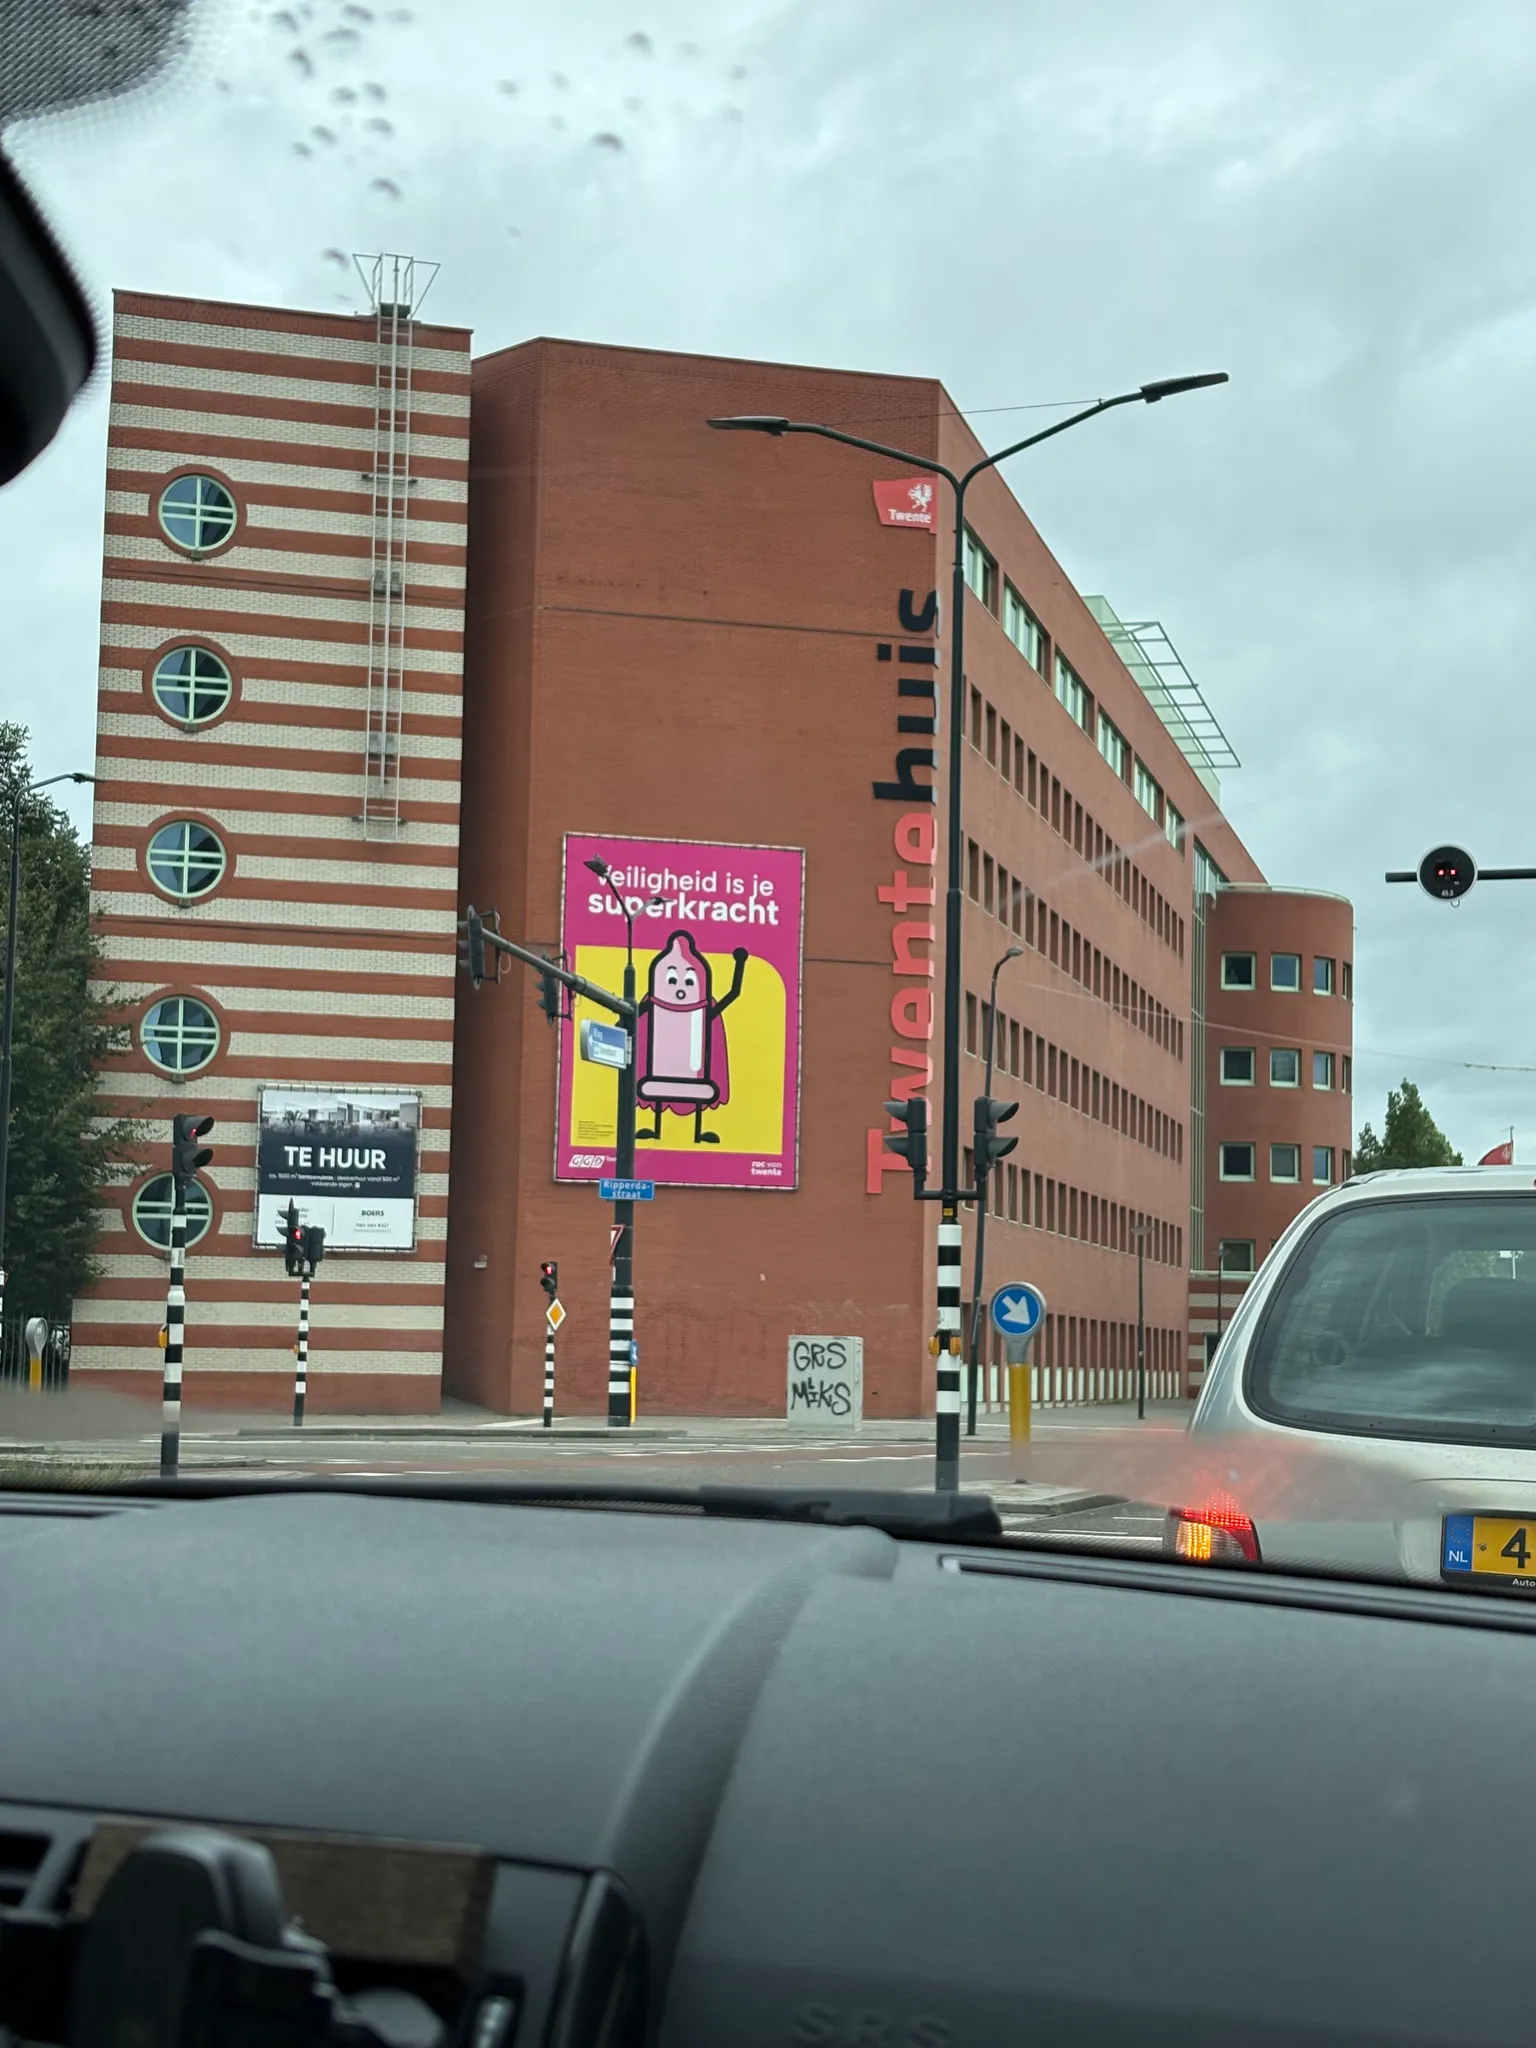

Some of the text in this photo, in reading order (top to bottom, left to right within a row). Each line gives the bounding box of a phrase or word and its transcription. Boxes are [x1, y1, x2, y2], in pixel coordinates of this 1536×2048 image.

[888, 508, 932, 523] Twente
[725, 872, 744, 894] is
[750, 874, 774, 899] je
[588, 892, 779, 925] superkracht
[284, 1145, 387, 1170] TE HUUR
[569, 1154, 605, 1169] GGD
[751, 1167, 782, 1176] twente
[603, 1180, 651, 1190] Ripperda-
[612, 1190, 641, 1199] straat
[1501, 1527, 1531, 1569] 4
[1448, 1550, 1468, 1563] NL
